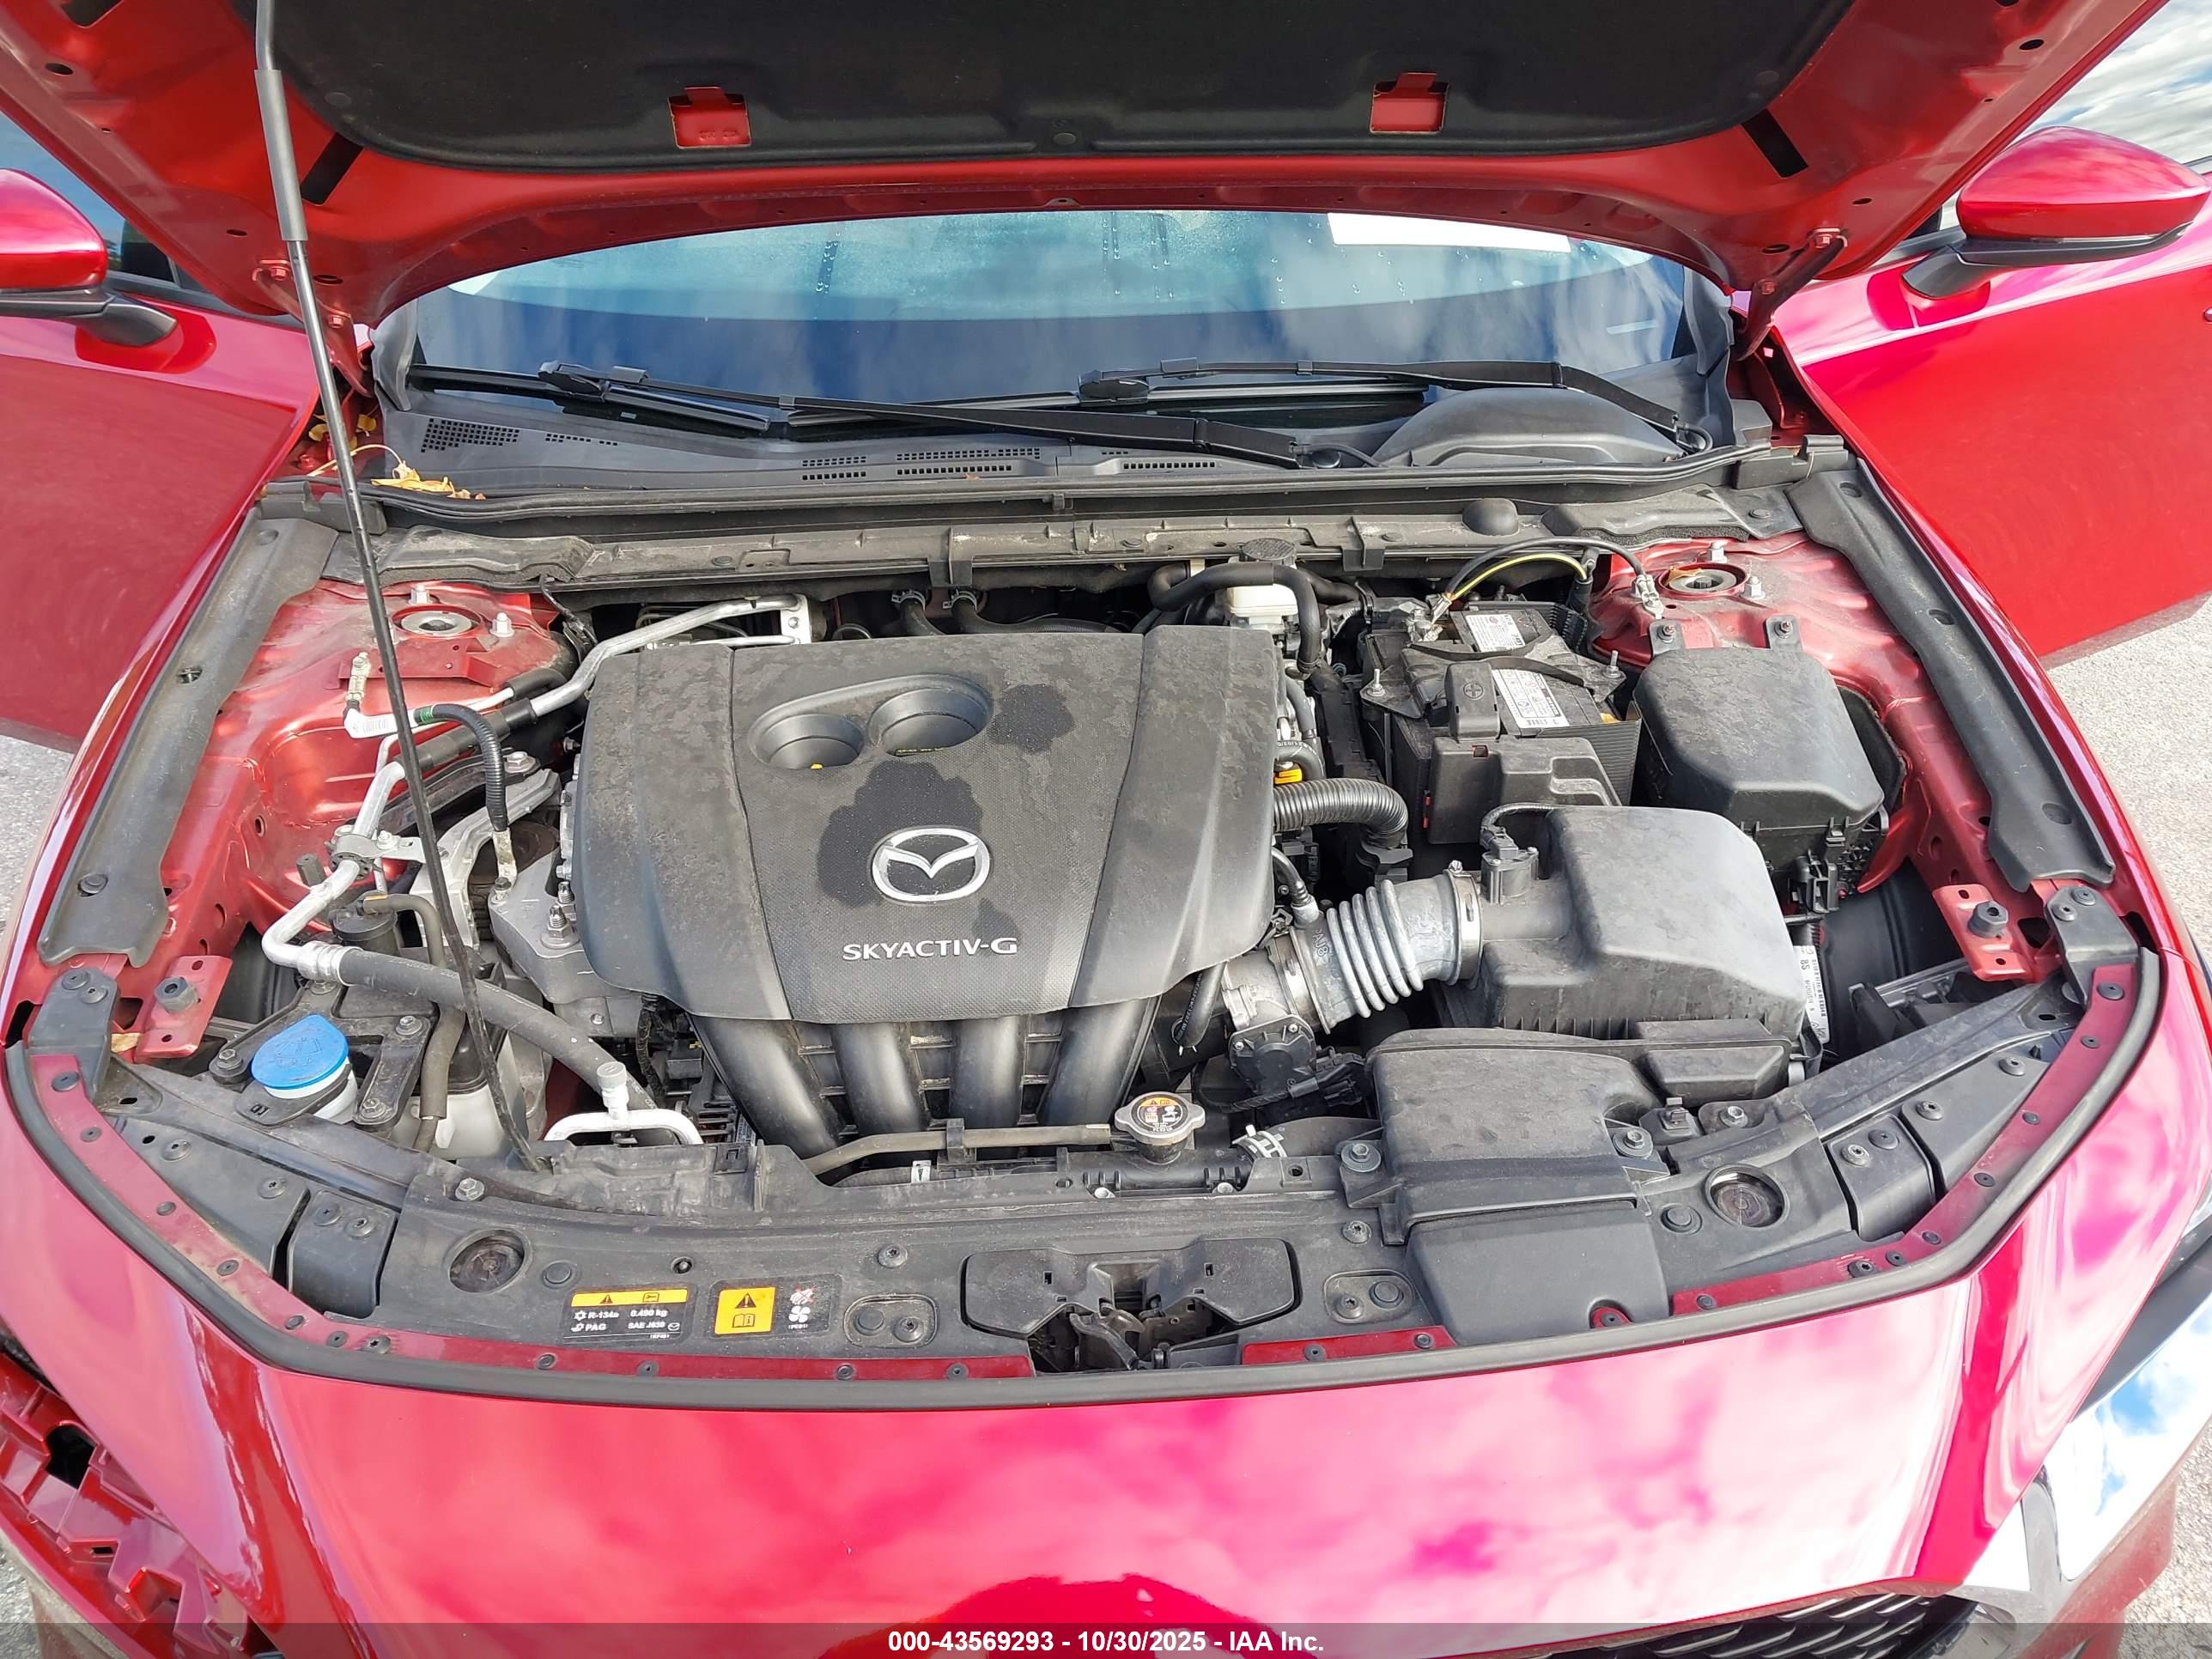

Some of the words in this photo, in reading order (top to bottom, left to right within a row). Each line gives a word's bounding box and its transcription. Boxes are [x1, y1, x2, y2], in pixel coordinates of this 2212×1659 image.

[842, 936, 1018, 961] SKYACTIV-G
[587, 1310, 620, 1319] R-134a
[655, 1310, 668, 1318] kg
[585, 1323, 606, 1332] PAG
